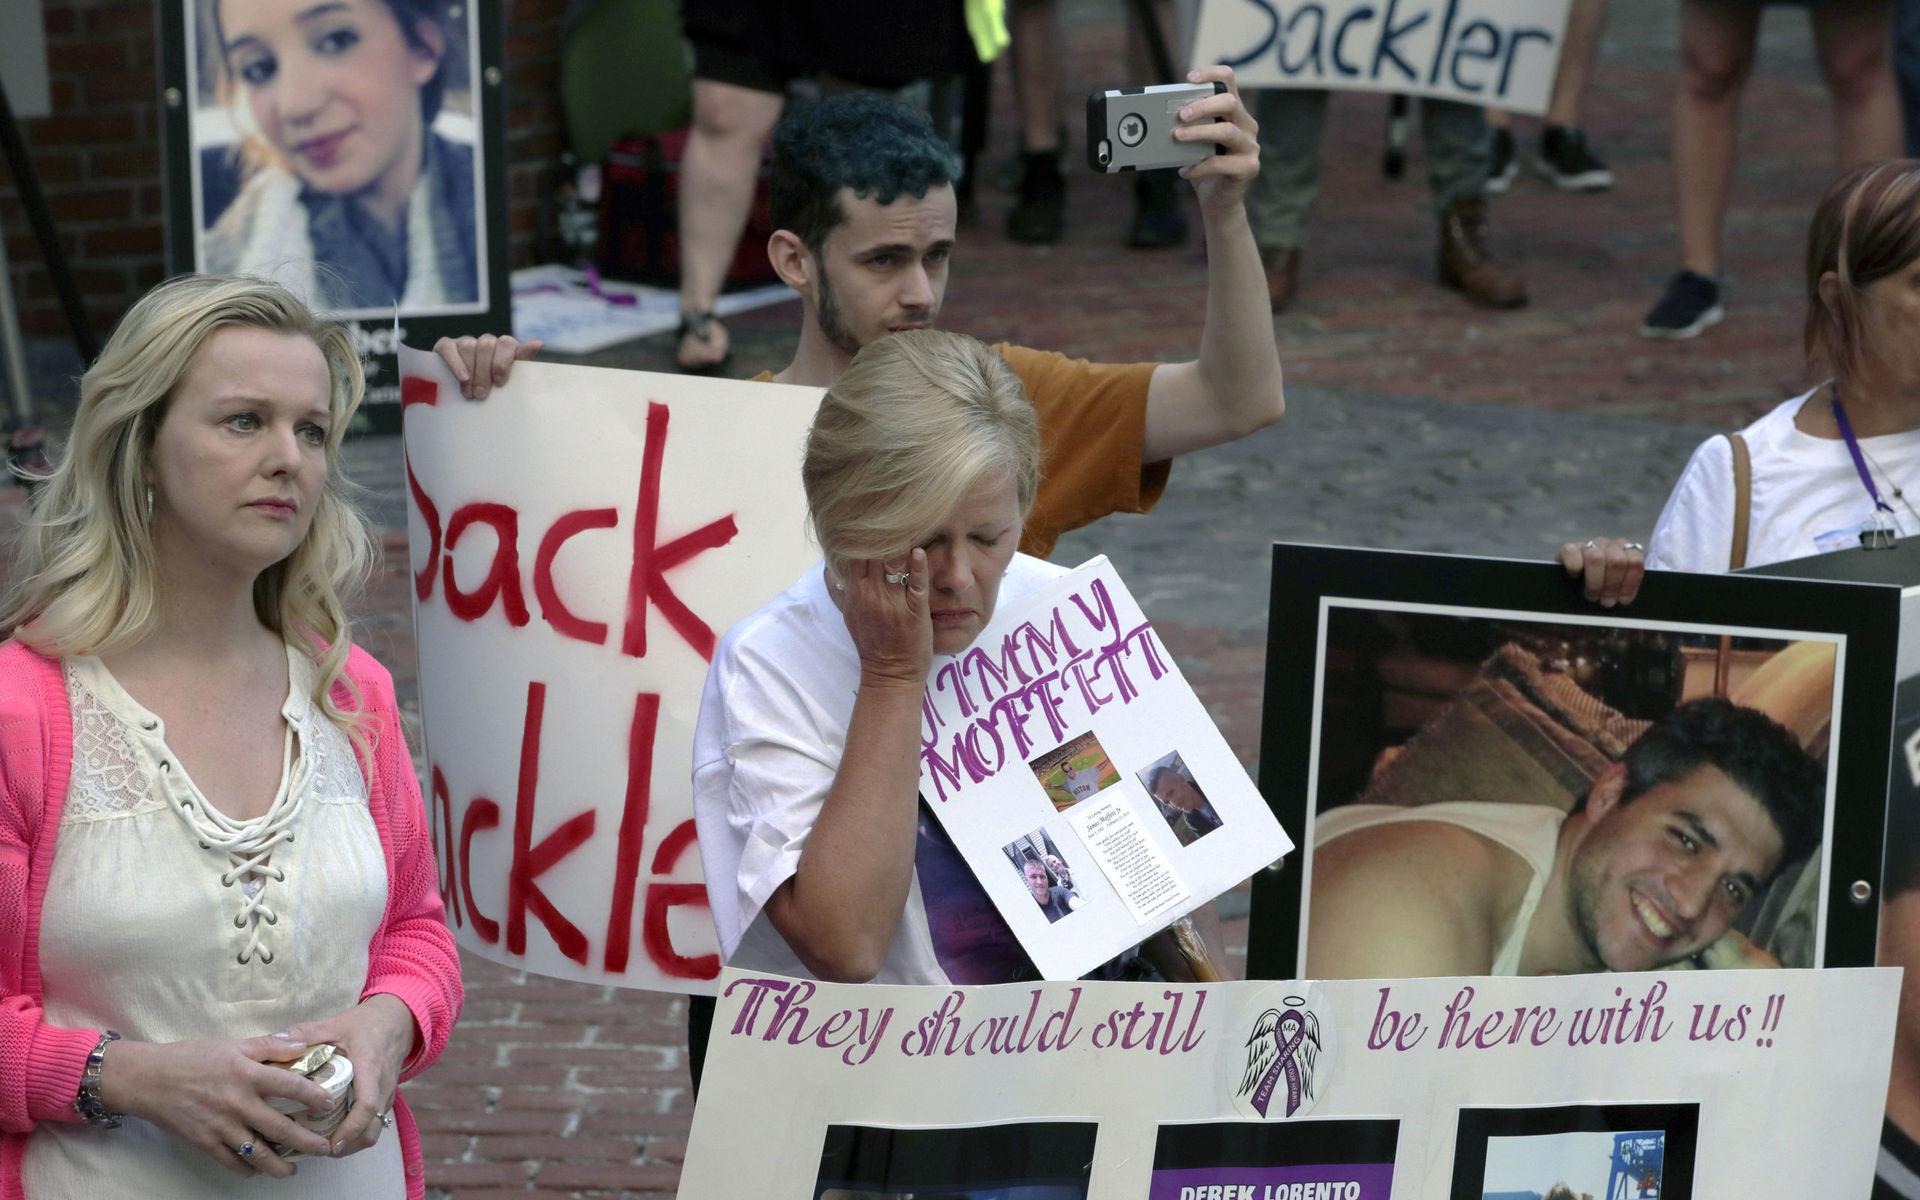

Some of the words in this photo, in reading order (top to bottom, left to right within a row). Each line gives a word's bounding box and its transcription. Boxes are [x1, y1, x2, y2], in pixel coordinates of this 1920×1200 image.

[920, 621, 1169, 802] MOFFETT
[724, 978, 894, 1065] They
[900, 989, 1084, 1057] should
[1091, 989, 1208, 1056] still
[1367, 986, 1428, 1051] be
[1437, 985, 1562, 1050] here
[1567, 980, 1673, 1047] with
[1257, 1076, 1275, 1102] TEAM
[1272, 1037, 1300, 1076] SHARING
[1263, 1181, 1361, 1200] LORENTO
